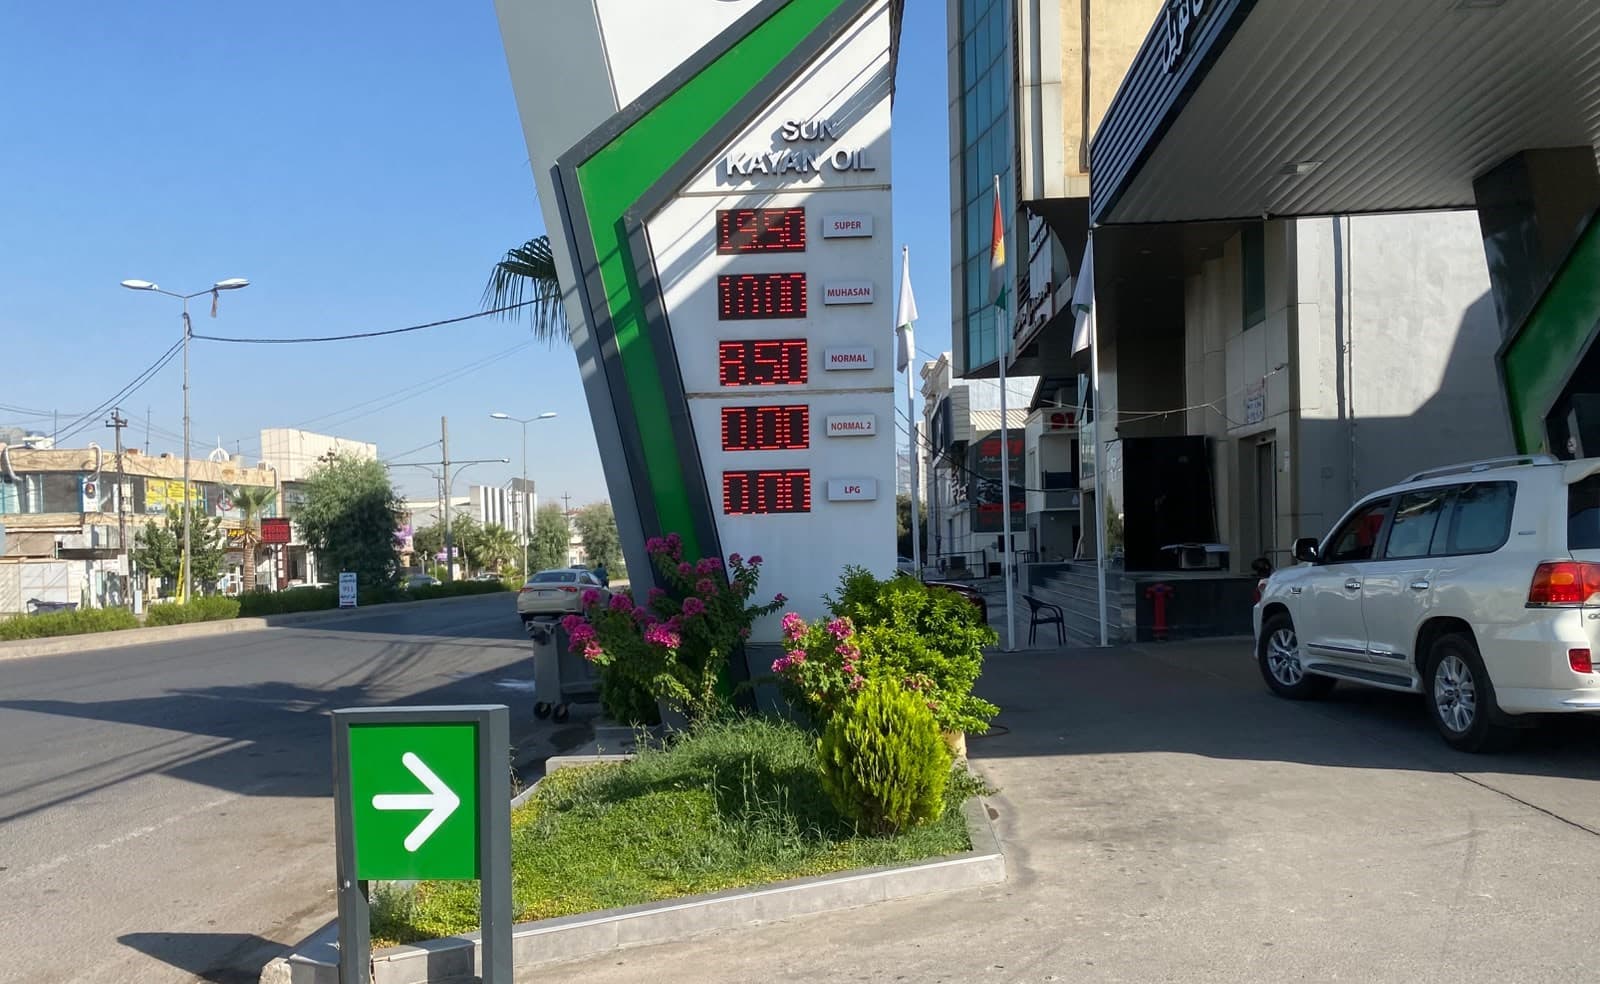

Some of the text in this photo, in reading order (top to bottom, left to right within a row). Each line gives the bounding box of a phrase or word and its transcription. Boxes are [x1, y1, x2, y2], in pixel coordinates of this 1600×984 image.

[781, 118, 838, 141] SUN
[725, 146, 876, 176] KAYAN OIL
[833, 221, 862, 230] SUPER
[827, 288, 870, 297] MUHASAN
[831, 354, 867, 363] NORMAL
[831, 422, 872, 431] NORMAL 2
[844, 485, 861, 494] LPG
